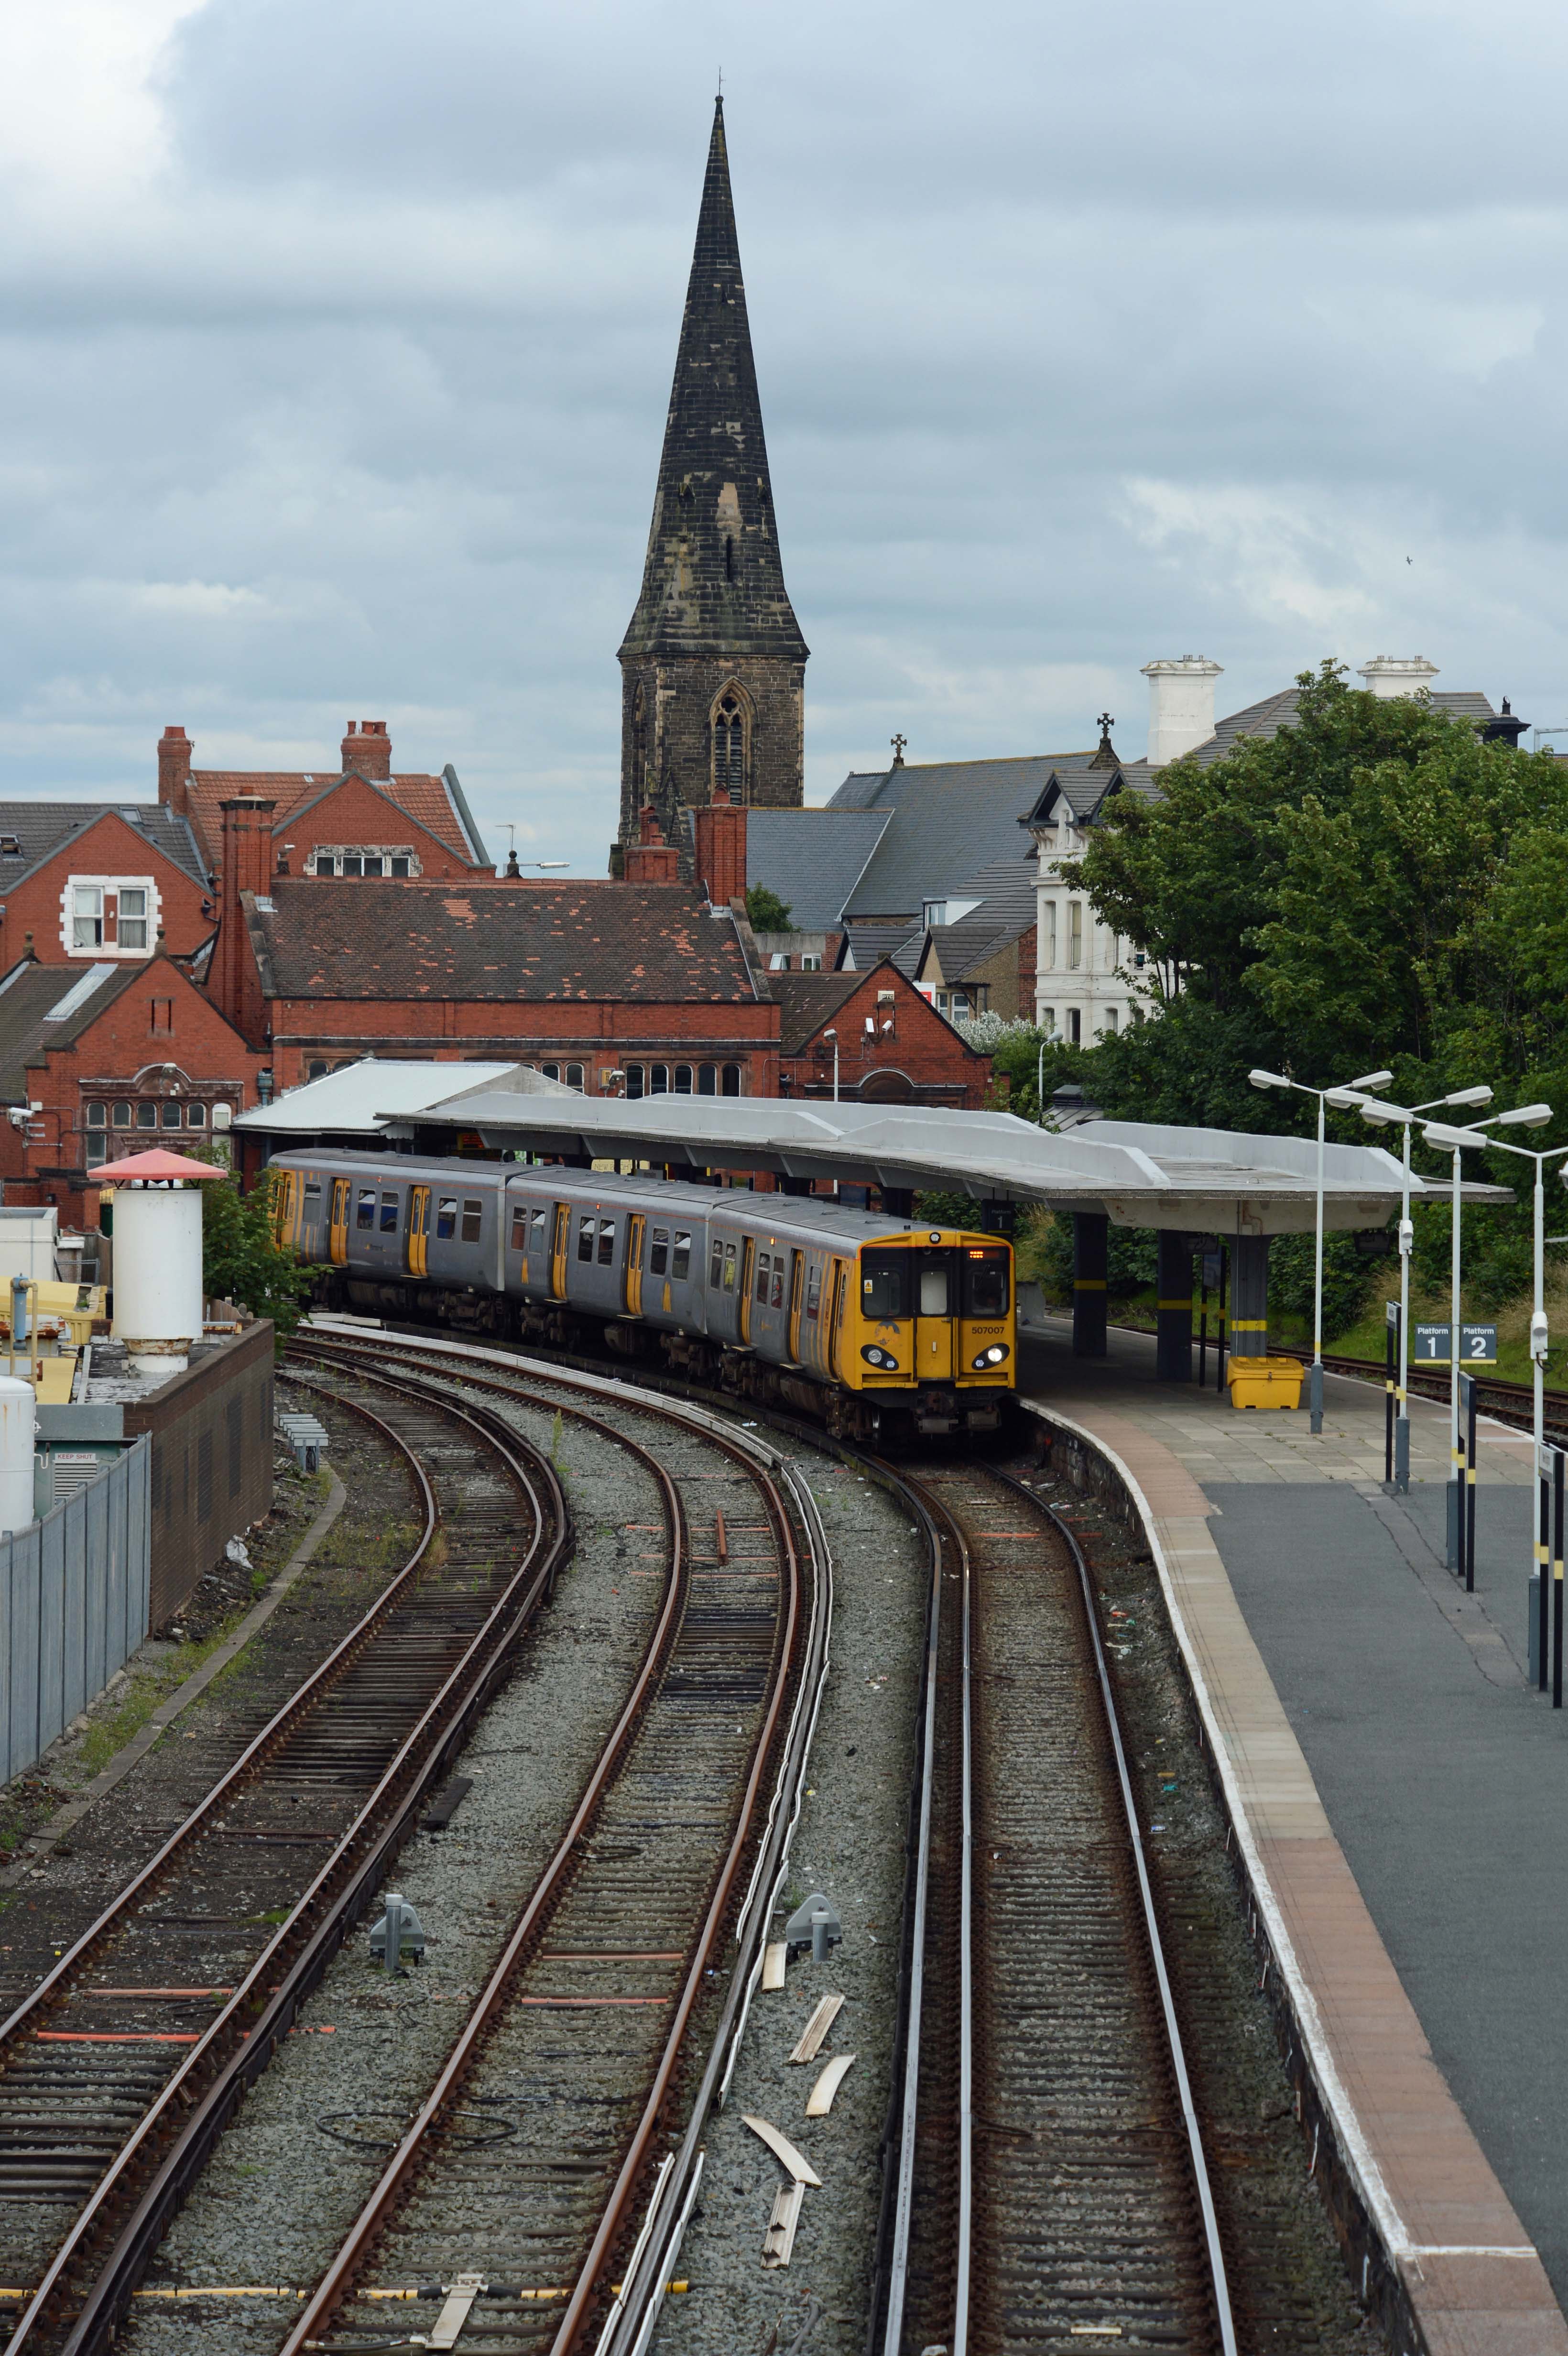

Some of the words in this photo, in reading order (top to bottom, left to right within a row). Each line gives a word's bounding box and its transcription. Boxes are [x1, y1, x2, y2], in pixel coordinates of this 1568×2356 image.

[998, 1216, 1002, 1228] 1
[1427, 1337, 1436, 1357] 1
[1471, 1336, 1486, 1357] 2
